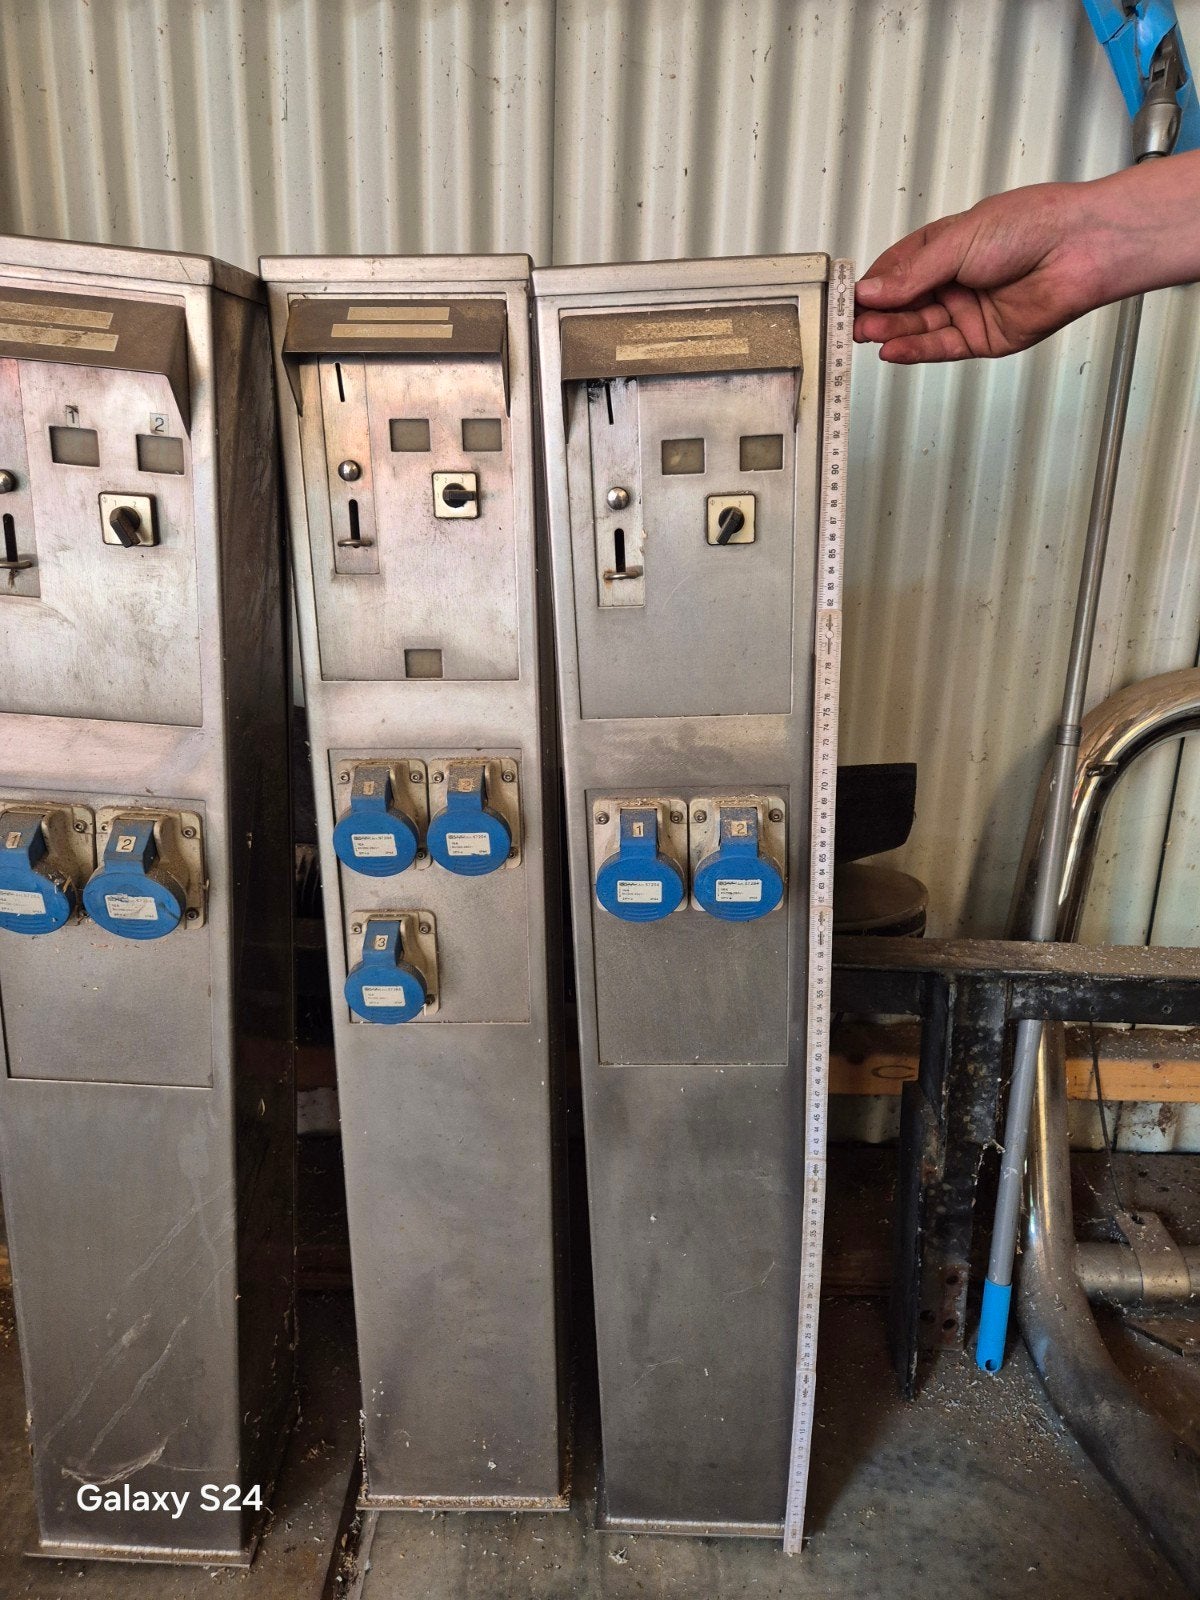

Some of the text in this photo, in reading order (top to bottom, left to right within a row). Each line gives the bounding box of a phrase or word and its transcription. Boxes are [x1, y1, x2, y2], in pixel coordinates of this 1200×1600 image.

[837, 322, 844, 330] 98
[836, 341, 843, 349] 97
[836, 359, 842, 367] 96
[835, 375, 842, 386] 95
[834, 395, 841, 403] 94
[834, 412, 841, 421] 93
[154, 417, 165, 433] 2
[833, 430, 840, 439] 92
[831, 464, 839, 475] 90
[831, 482, 838, 491] 89
[831, 499, 837, 508] 88
[830, 517, 837, 525] 87
[829, 533, 836, 541] 86
[828, 549, 836, 558] 85
[828, 566, 835, 574] 84
[827, 582, 834, 590] 83
[827, 598, 834, 606] 82
[825, 662, 832, 670] 78
[824, 693, 831, 701] 76
[823, 707, 831, 717] 75
[823, 723, 830, 731] 74
[823, 738, 829, 746] 73
[822, 753, 829, 761] 72
[462, 781, 471, 791] 2
[821, 781, 829, 791] 70
[821, 797, 828, 805] 69
[636, 825, 642, 836] 1
[736, 823, 745, 835] 2
[820, 826, 827, 834] 67
[11, 835, 18, 846] 1
[121, 838, 132, 851] 2
[819, 854, 827, 863] 65
[818, 882, 825, 890] 63
[377, 937, 386, 948] 3
[816, 990, 824, 998] 55
[814, 1053, 822, 1061] 50
[813, 1113, 821, 1121] 45
[807, 1282, 814, 1290] 30
